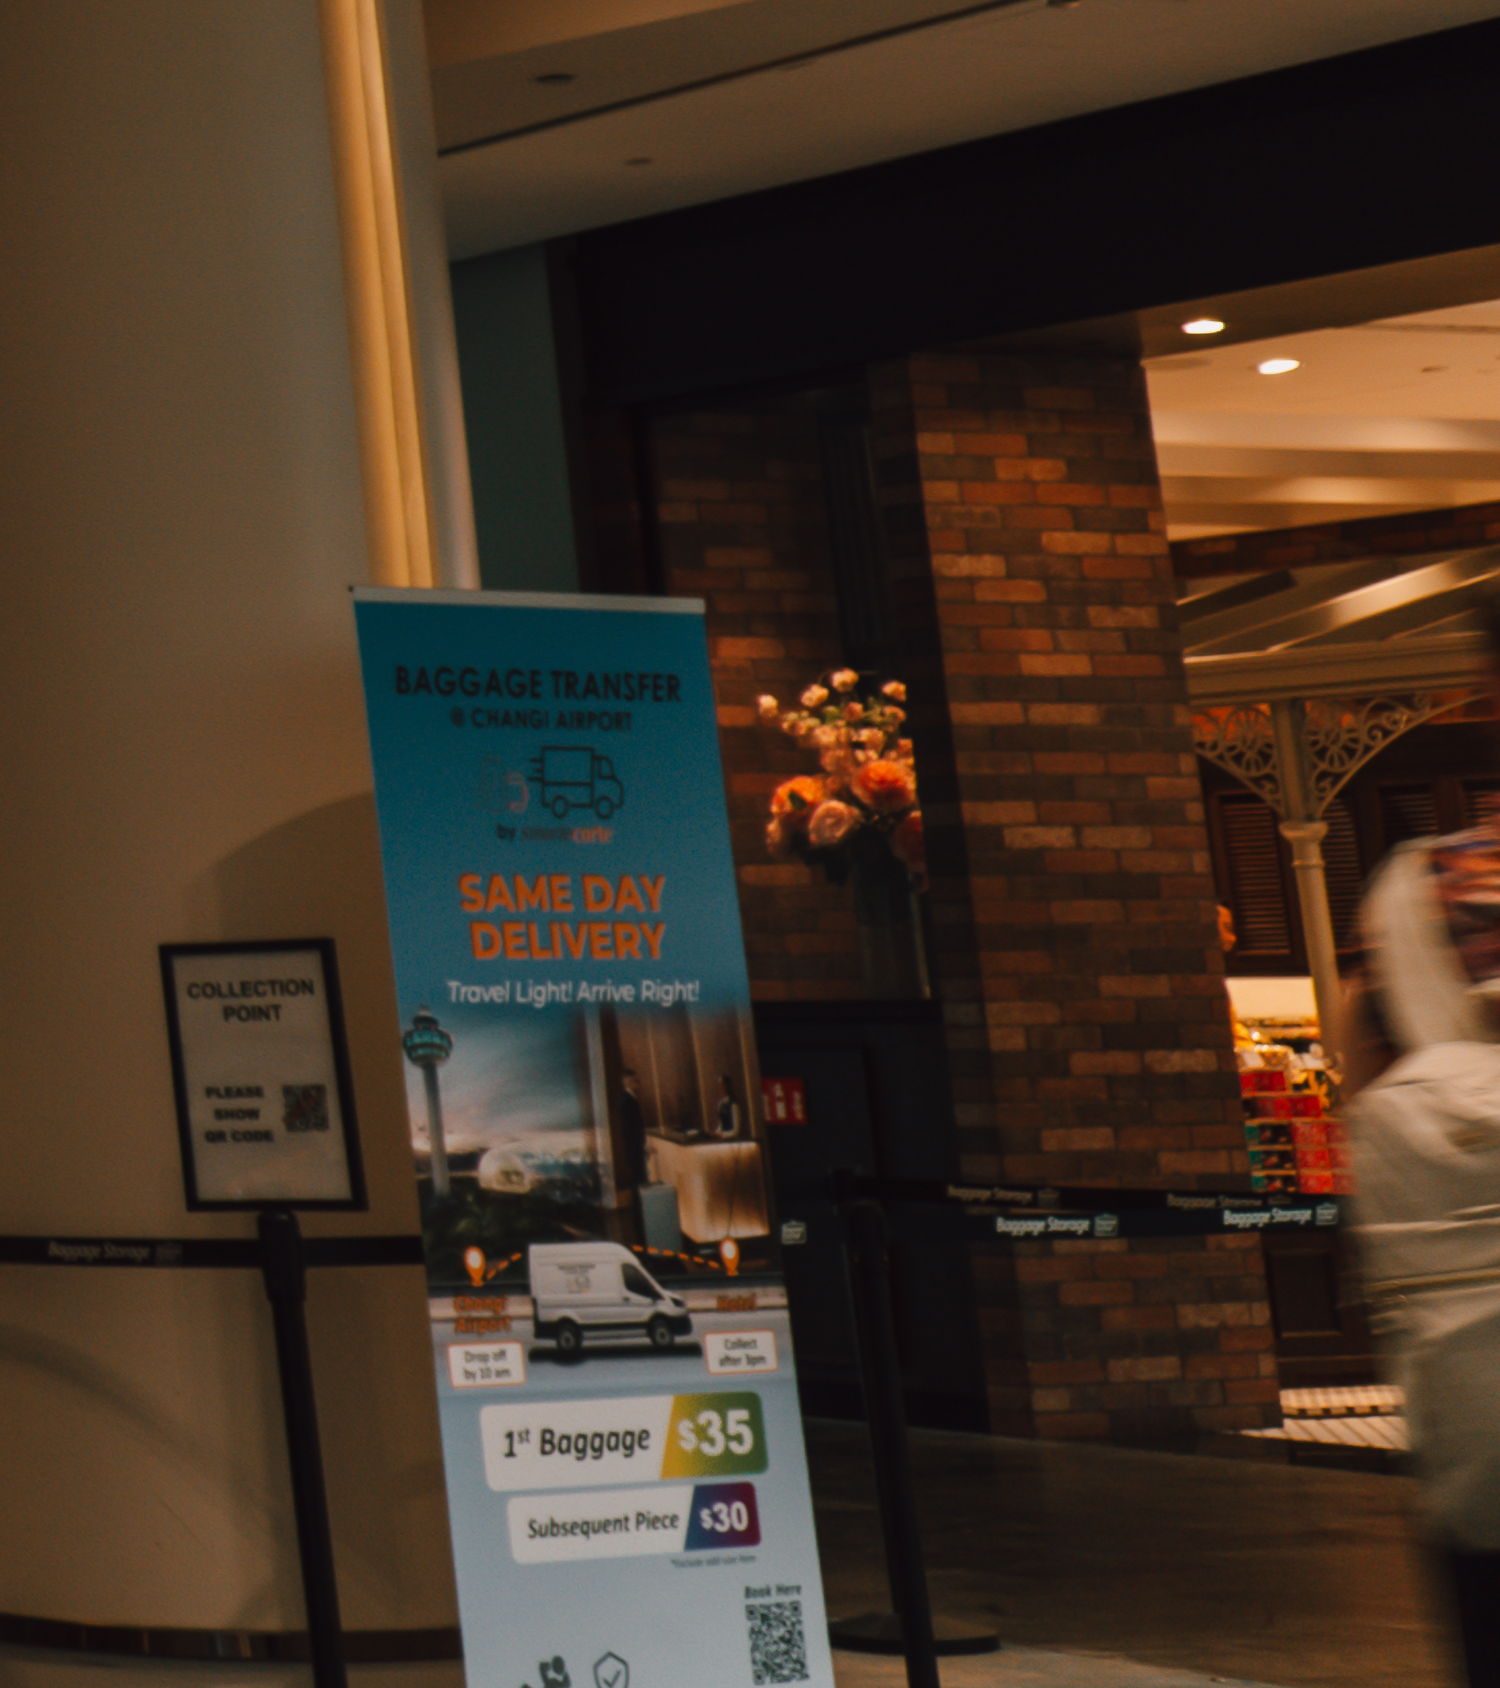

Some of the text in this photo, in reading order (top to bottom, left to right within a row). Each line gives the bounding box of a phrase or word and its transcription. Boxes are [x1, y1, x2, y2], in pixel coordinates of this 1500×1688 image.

[394, 665, 682, 703] BAGGAGE TRANSFER
[471, 707, 550, 729] CHANGI
[556, 710, 634, 732] AIRPORT
[497, 824, 517, 842] by
[458, 871, 667, 913] SAME DAY
[469, 920, 667, 960] DELIVERY
[186, 978, 316, 999] COLLECTION
[446, 979, 701, 1009] Travel Light! Arrive Right!
[222, 1004, 282, 1022] POINT
[204, 1085, 264, 1099] PLEASE
[214, 1108, 260, 1121] SHOW
[204, 1130, 275, 1143] QR CODE
[947, 1184, 1034, 1205] Baggage Storage
[995, 1216, 1091, 1237] Baggage Storage
[1222, 1207, 1313, 1229] Baggage Storage
[48, 1240, 152, 1263] Baggage Storage
[453, 1294, 509, 1316] Changi
[455, 1315, 512, 1337] Airport
[723, 1337, 758, 1350] Collect
[463, 1350, 490, 1364] Drop
[539, 1427, 652, 1463] Baggage
[676, 1408, 755, 1458] $35
[527, 1500, 750, 1540] Subsequent Piece $30
[744, 1583, 802, 1599] Book Here
